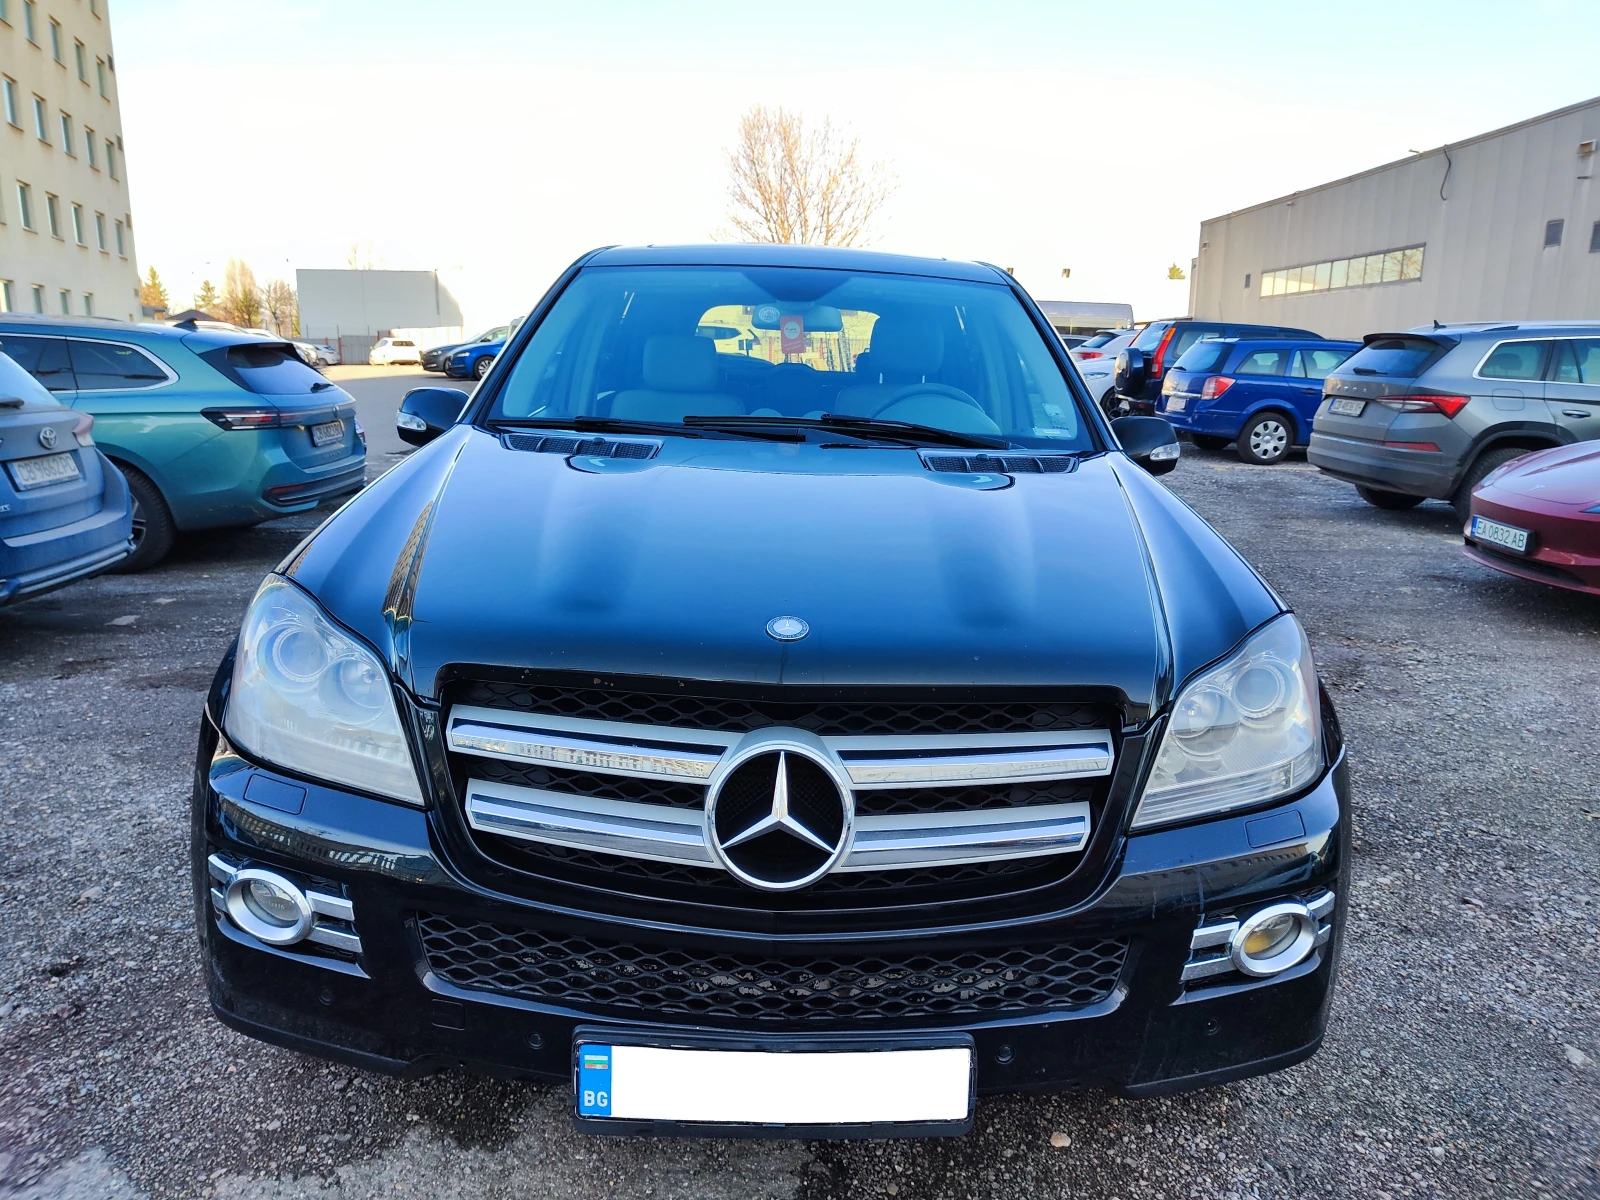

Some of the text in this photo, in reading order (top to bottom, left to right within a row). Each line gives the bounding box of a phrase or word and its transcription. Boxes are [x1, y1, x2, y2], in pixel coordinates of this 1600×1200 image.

[1476, 520, 1525, 548] EA 0832 AB
[584, 1090, 608, 1107] BG
